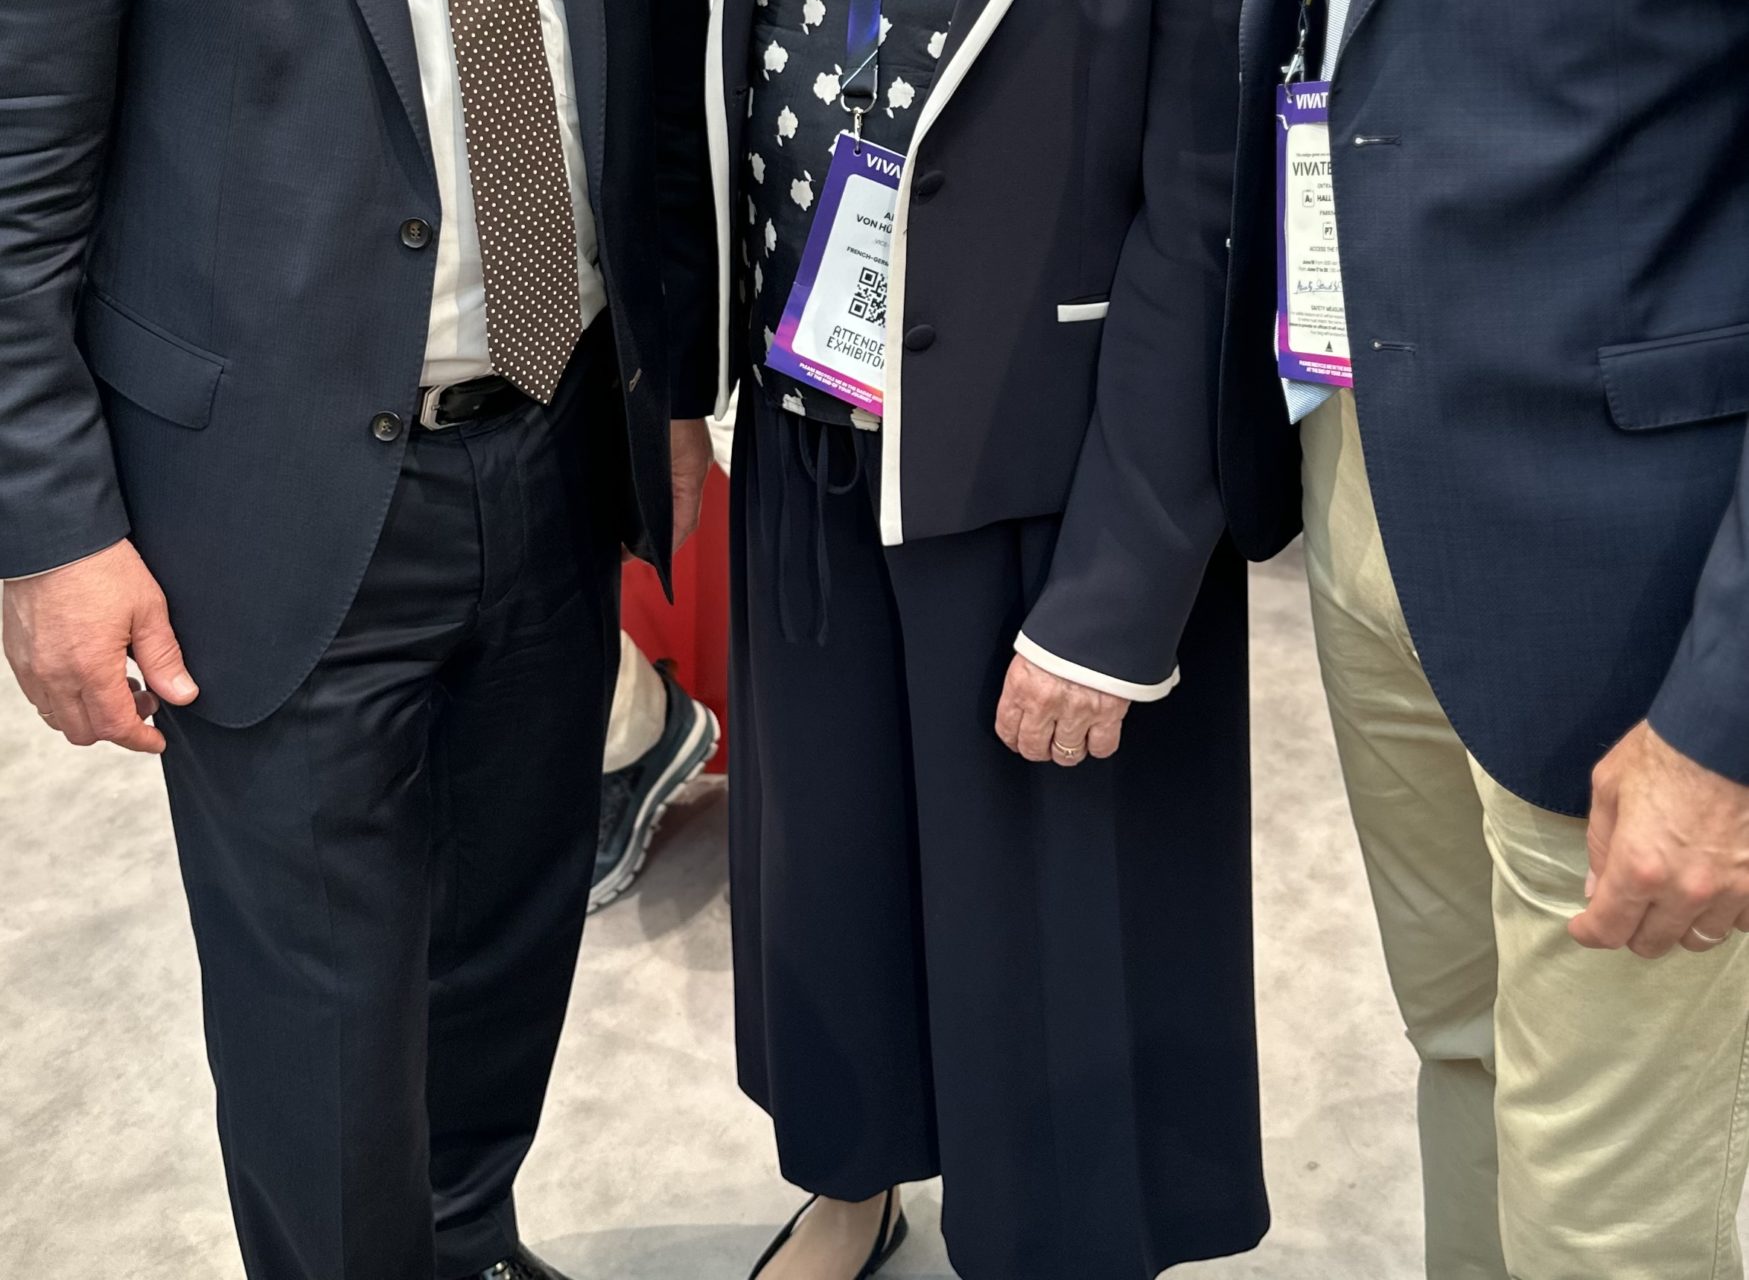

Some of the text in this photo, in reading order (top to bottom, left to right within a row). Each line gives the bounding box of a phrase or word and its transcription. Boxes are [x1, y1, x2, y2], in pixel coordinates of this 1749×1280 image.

[1296, 92, 1329, 109] VIVAT
[856, 214, 878, 229] VON
[833, 325, 885, 355] ATTENDE
